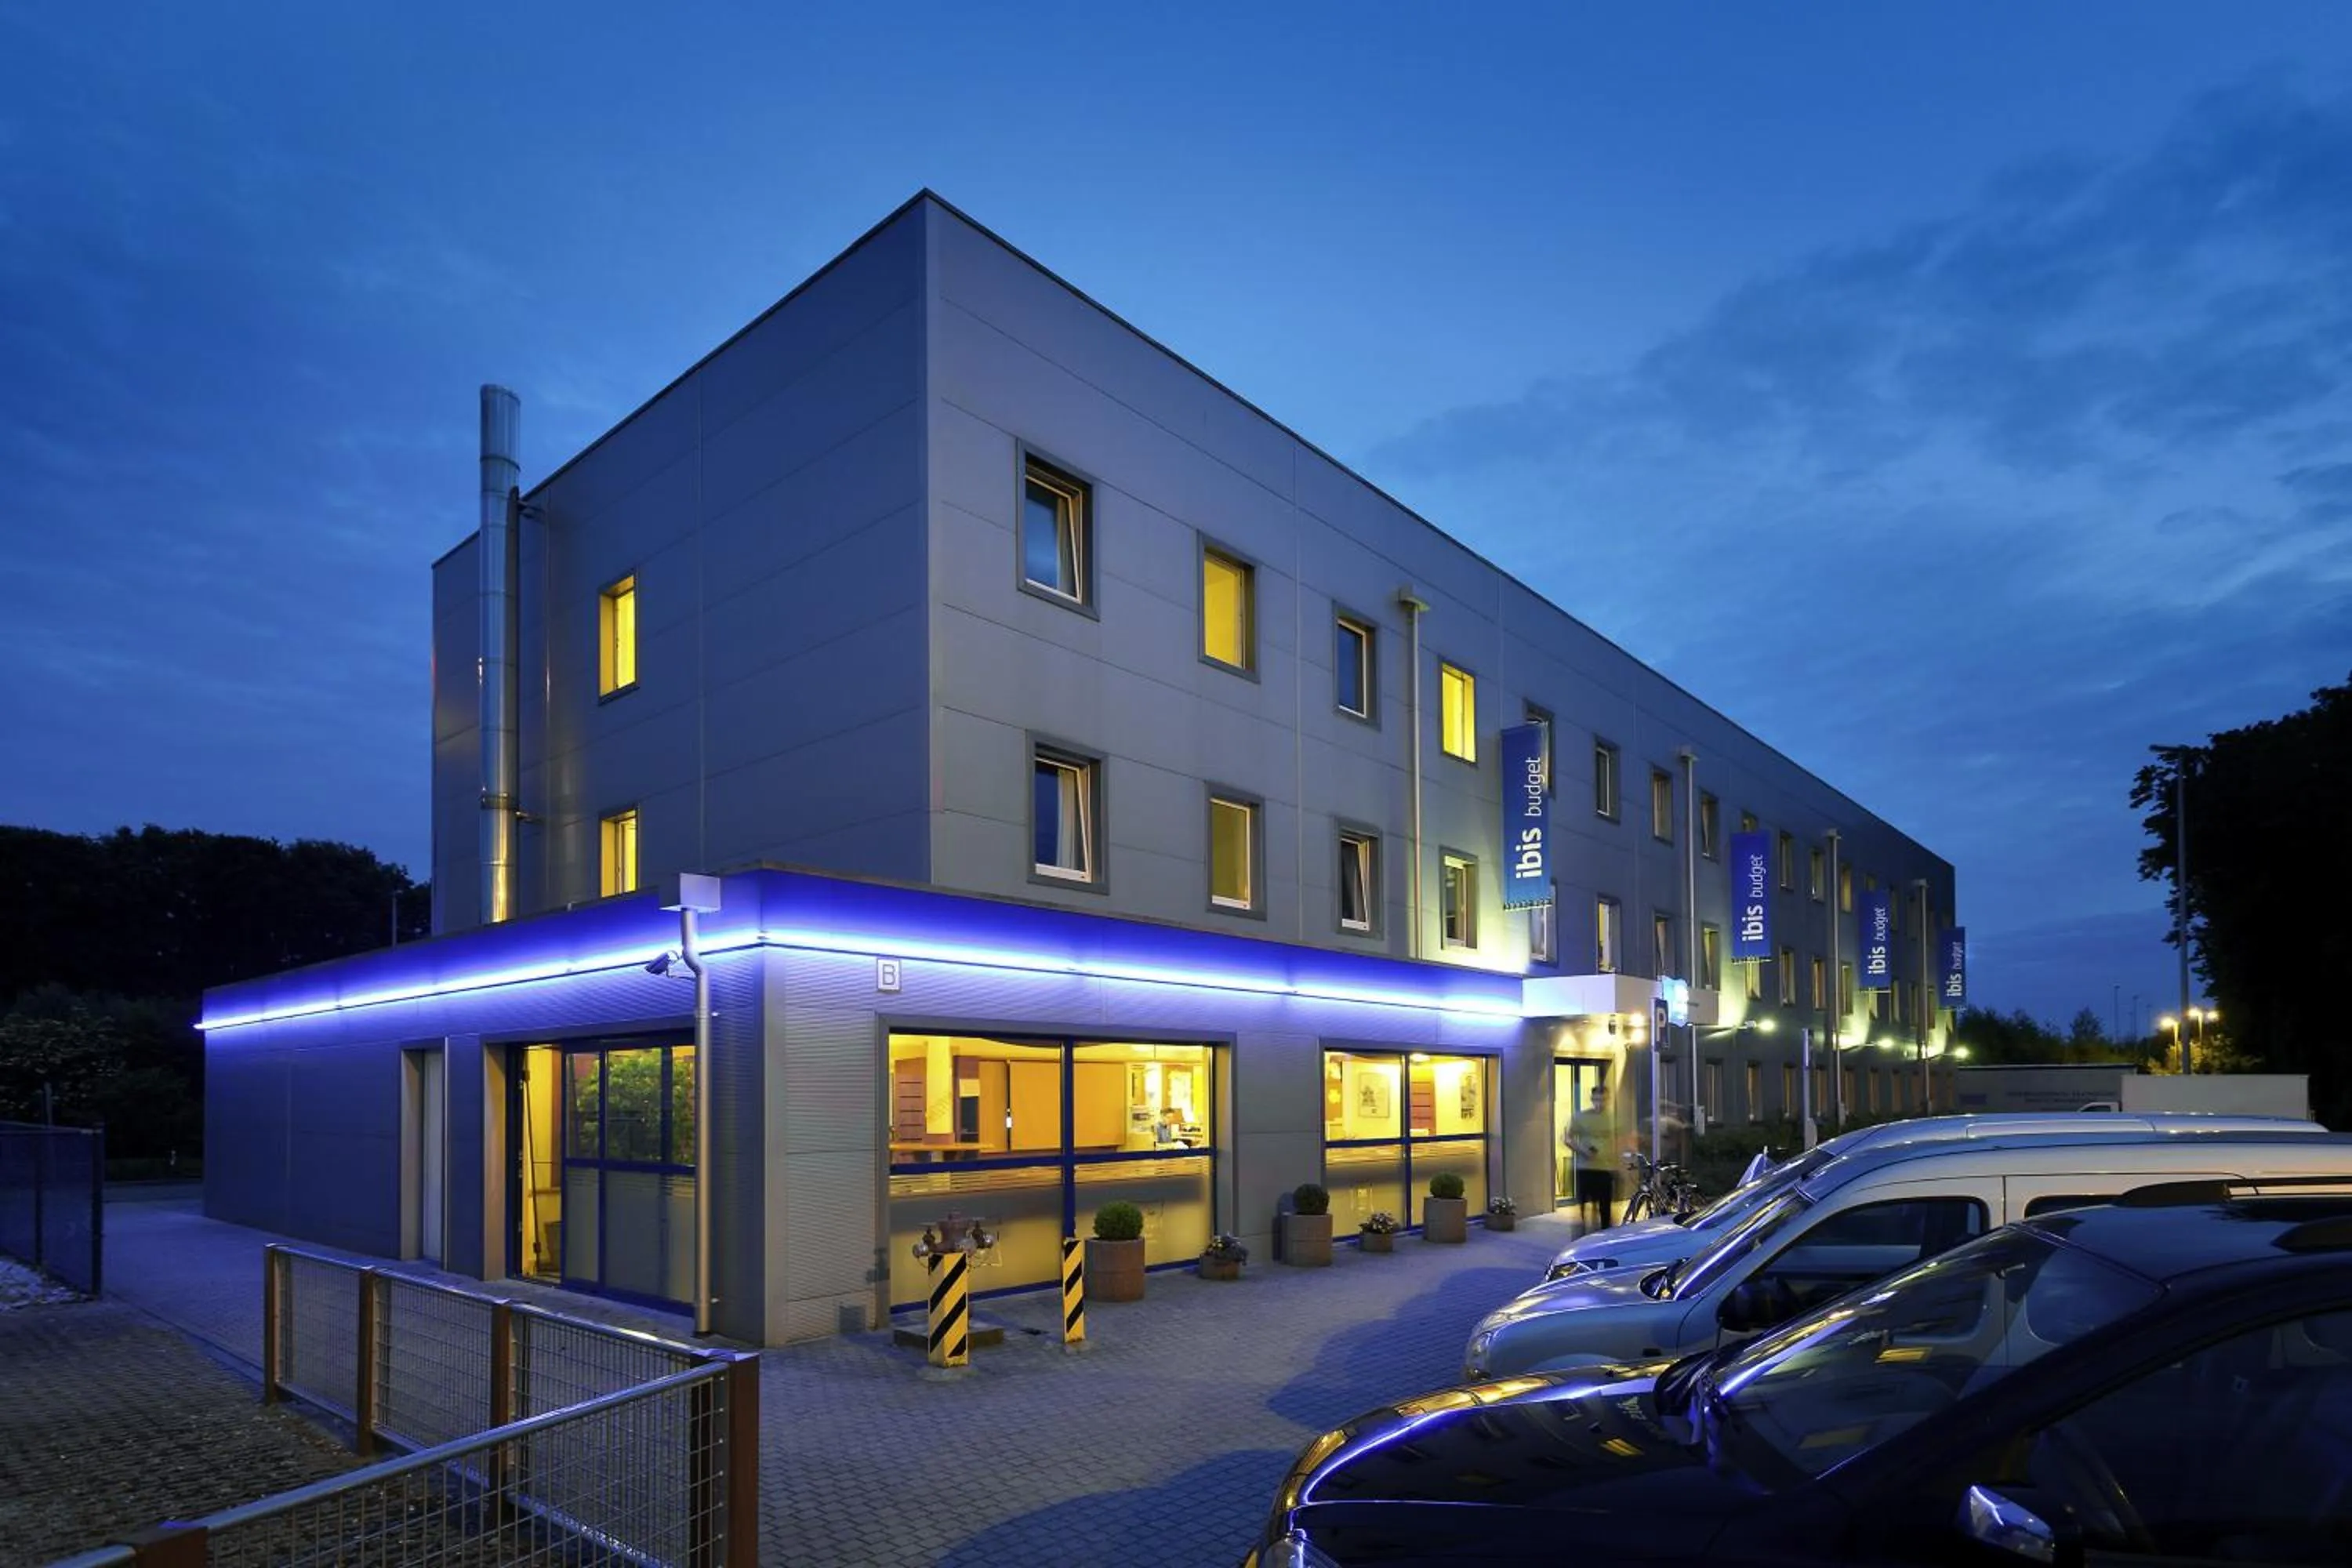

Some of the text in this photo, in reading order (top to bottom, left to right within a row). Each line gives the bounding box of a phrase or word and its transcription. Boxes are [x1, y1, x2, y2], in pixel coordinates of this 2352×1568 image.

[1516, 757, 1545, 879] ibis budget
[1741, 854, 1766, 942] ibis budget
[882, 964, 895, 985] B
[1867, 946, 1886, 975] ibis
[1946, 973, 1962, 996] ibis
[1656, 1007, 1666, 1042] P
